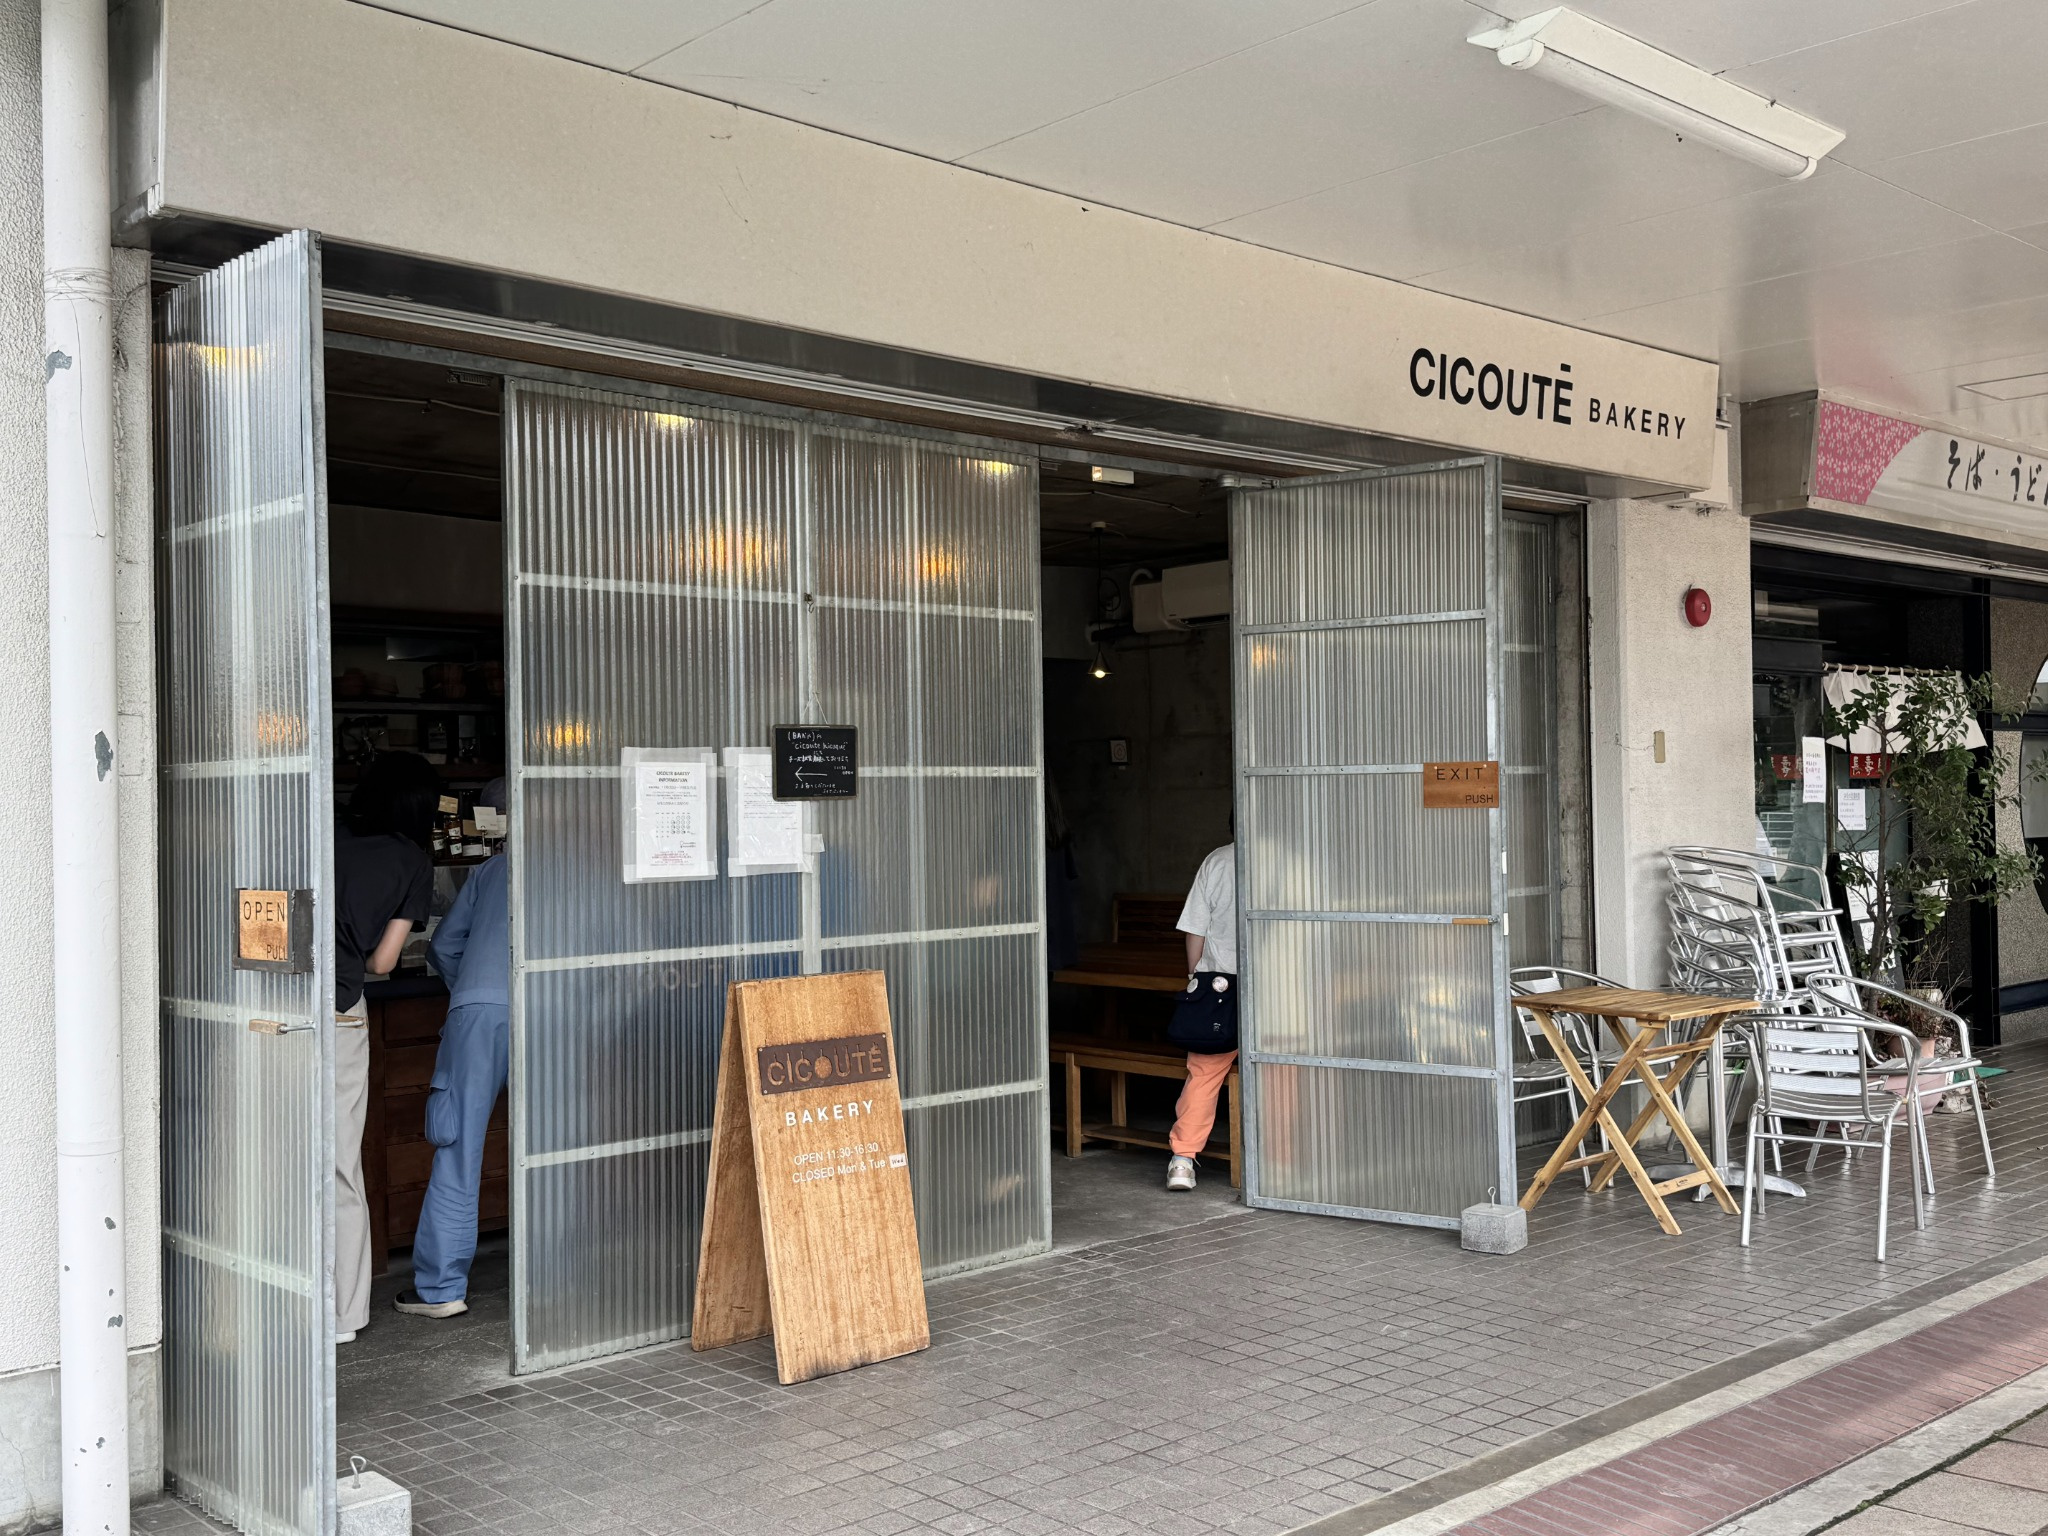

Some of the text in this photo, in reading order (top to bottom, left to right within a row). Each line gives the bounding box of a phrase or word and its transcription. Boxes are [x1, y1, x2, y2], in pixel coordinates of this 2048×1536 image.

[1589, 397, 1686, 440] BAKERY
[1436, 767, 1483, 781] EXIT
[1465, 794, 1494, 804] PUSH
[243, 900, 285, 922] OPEN
[266, 944, 288, 961] PULL
[785, 1099, 873, 1127] BAKERY
[794, 1142, 879, 1166] OPEN 11:30-16:30
[792, 1166, 835, 1183] CLOSED
[837, 1164, 856, 1175] Mon
[859, 1161, 866, 1172] &
[868, 1158, 886, 1169] Tue
